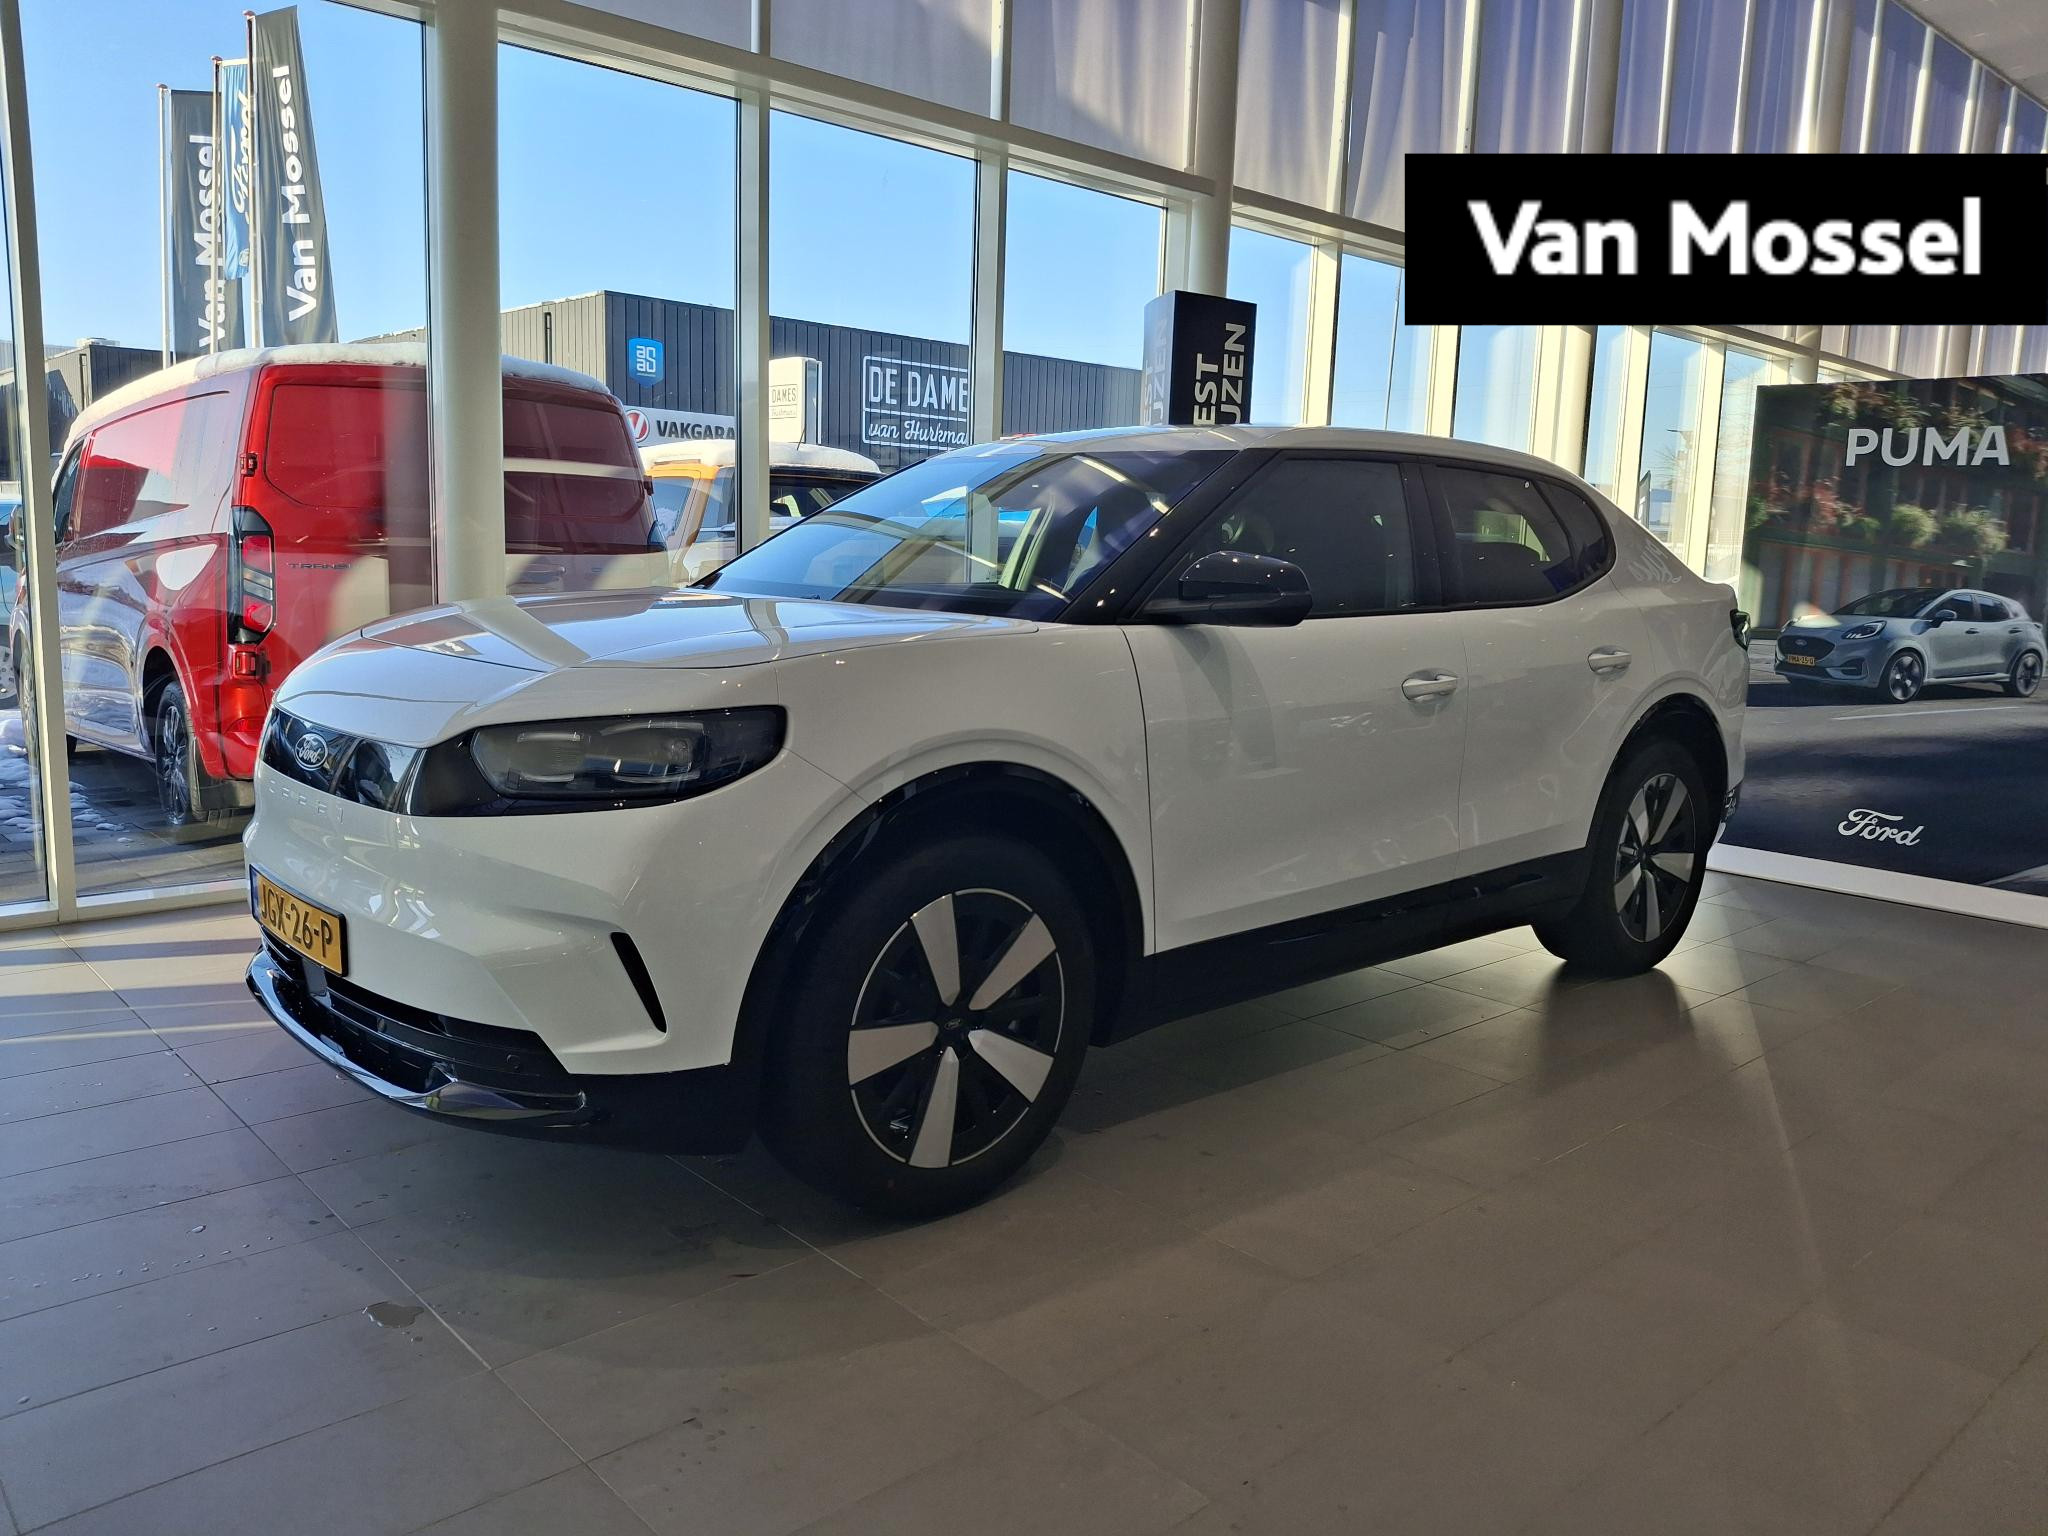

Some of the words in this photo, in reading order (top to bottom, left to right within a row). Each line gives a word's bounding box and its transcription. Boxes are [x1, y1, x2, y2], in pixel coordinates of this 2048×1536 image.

[272, 65, 311, 224] Mossel
[286, 239, 317, 322] Van
[868, 365, 898, 406] DE
[868, 423, 900, 438] van
[1845, 424, 2012, 467] PUMA
[1837, 808, 1925, 847] Ford
[260, 882, 334, 959] JGX-26-P
